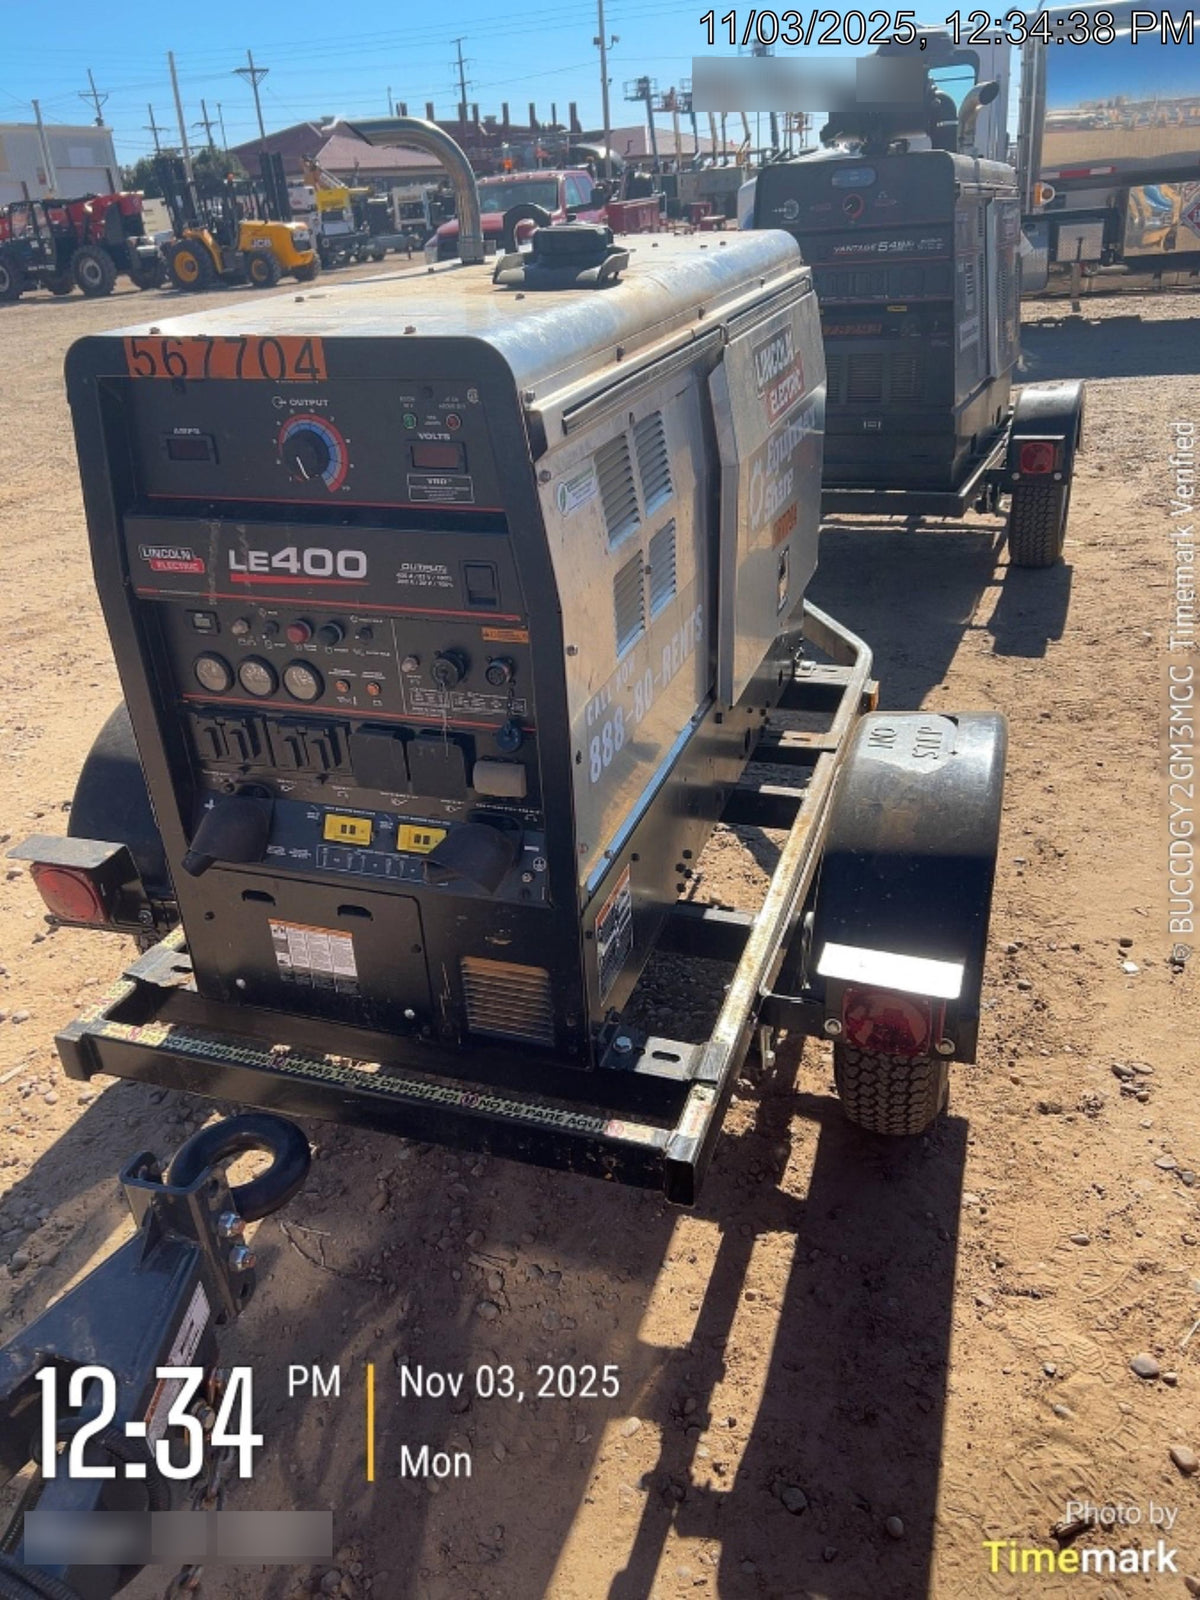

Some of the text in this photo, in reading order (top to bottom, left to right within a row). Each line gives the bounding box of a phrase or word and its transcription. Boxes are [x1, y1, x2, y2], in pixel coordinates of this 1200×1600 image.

[130, 336, 321, 380] 567704
[418, 432, 451, 440] VOLTS
[143, 549, 191, 561] LINCOLN
[156, 561, 199, 572] ELECTRIC
[228, 546, 368, 579] LE400
[589, 604, 703, 784] 888-80-RENTS
[586, 688, 613, 726] CALL
[868, 727, 897, 749] NO
[164, 1037, 190, 1048] NOT
[478, 1098, 500, 1109] NO
[524, 1106, 563, 1122] PARE
